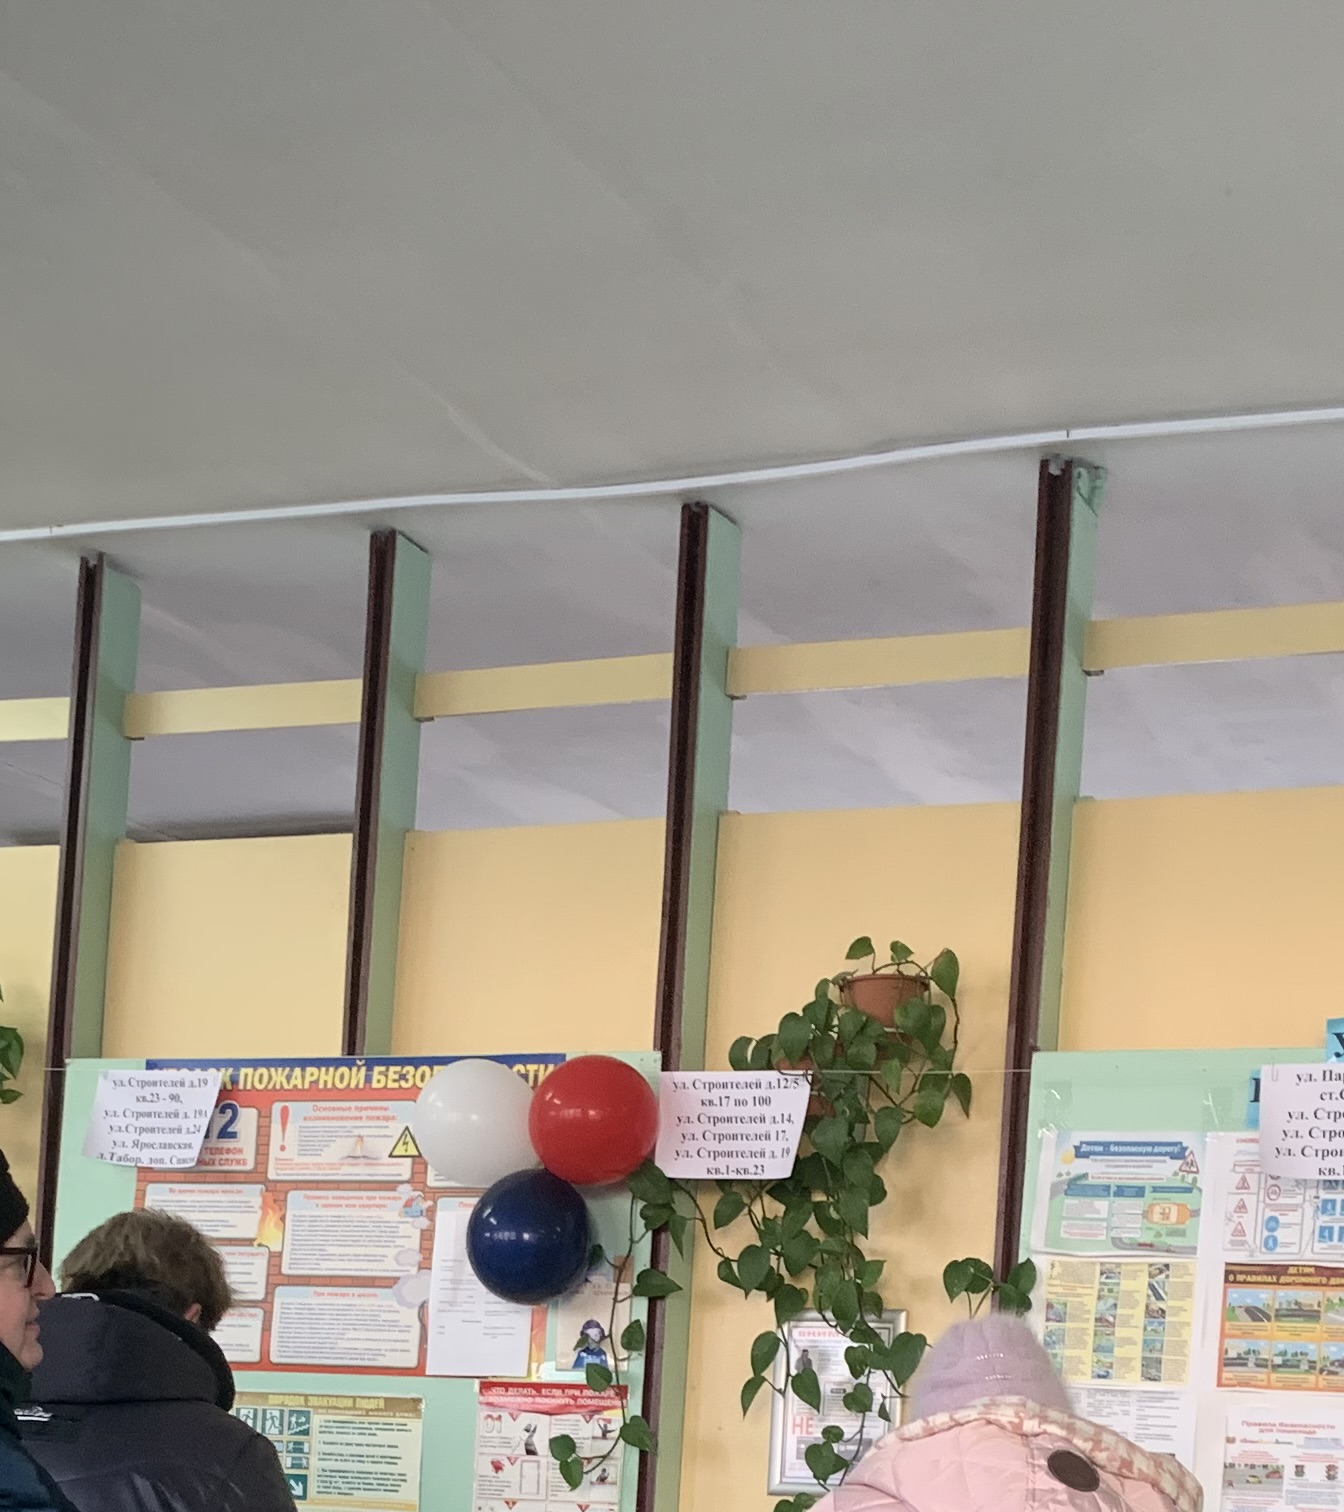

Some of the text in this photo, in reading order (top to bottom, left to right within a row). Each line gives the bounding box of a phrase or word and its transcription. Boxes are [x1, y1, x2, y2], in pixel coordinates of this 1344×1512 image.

[239, 1060, 367, 1090] ПОЖАРНОЙ
[1295, 1072, 1317, 1087] ул.
[112, 1079, 126, 1090] ул.
[128, 1077, 185, 1090] Строителей
[188, 1078, 208, 1089] д.19
[672, 1078, 800, 1093] ул. Строителей д.12/5
[136, 1092, 160, 1103] кв.23
[700, 1095, 772, 1107] кв.17 по 100
[103, 1109, 119, 1119] ул.
[123, 1108, 179, 1121] Строителей
[676, 1115, 694, 1127] ул.
[697, 1112, 766, 1127] Строителей
[1286, 1111, 1308, 1123] ул.
[680, 1132, 699, 1144] ул.
[702, 1129, 771, 1144] Строителей
[1281, 1129, 1303, 1142] ул.
[111, 1140, 128, 1150] ул.
[674, 1149, 693, 1161] ул.
[696, 1147, 766, 1161] Строителей
[1274, 1146, 1296, 1159] ул.
